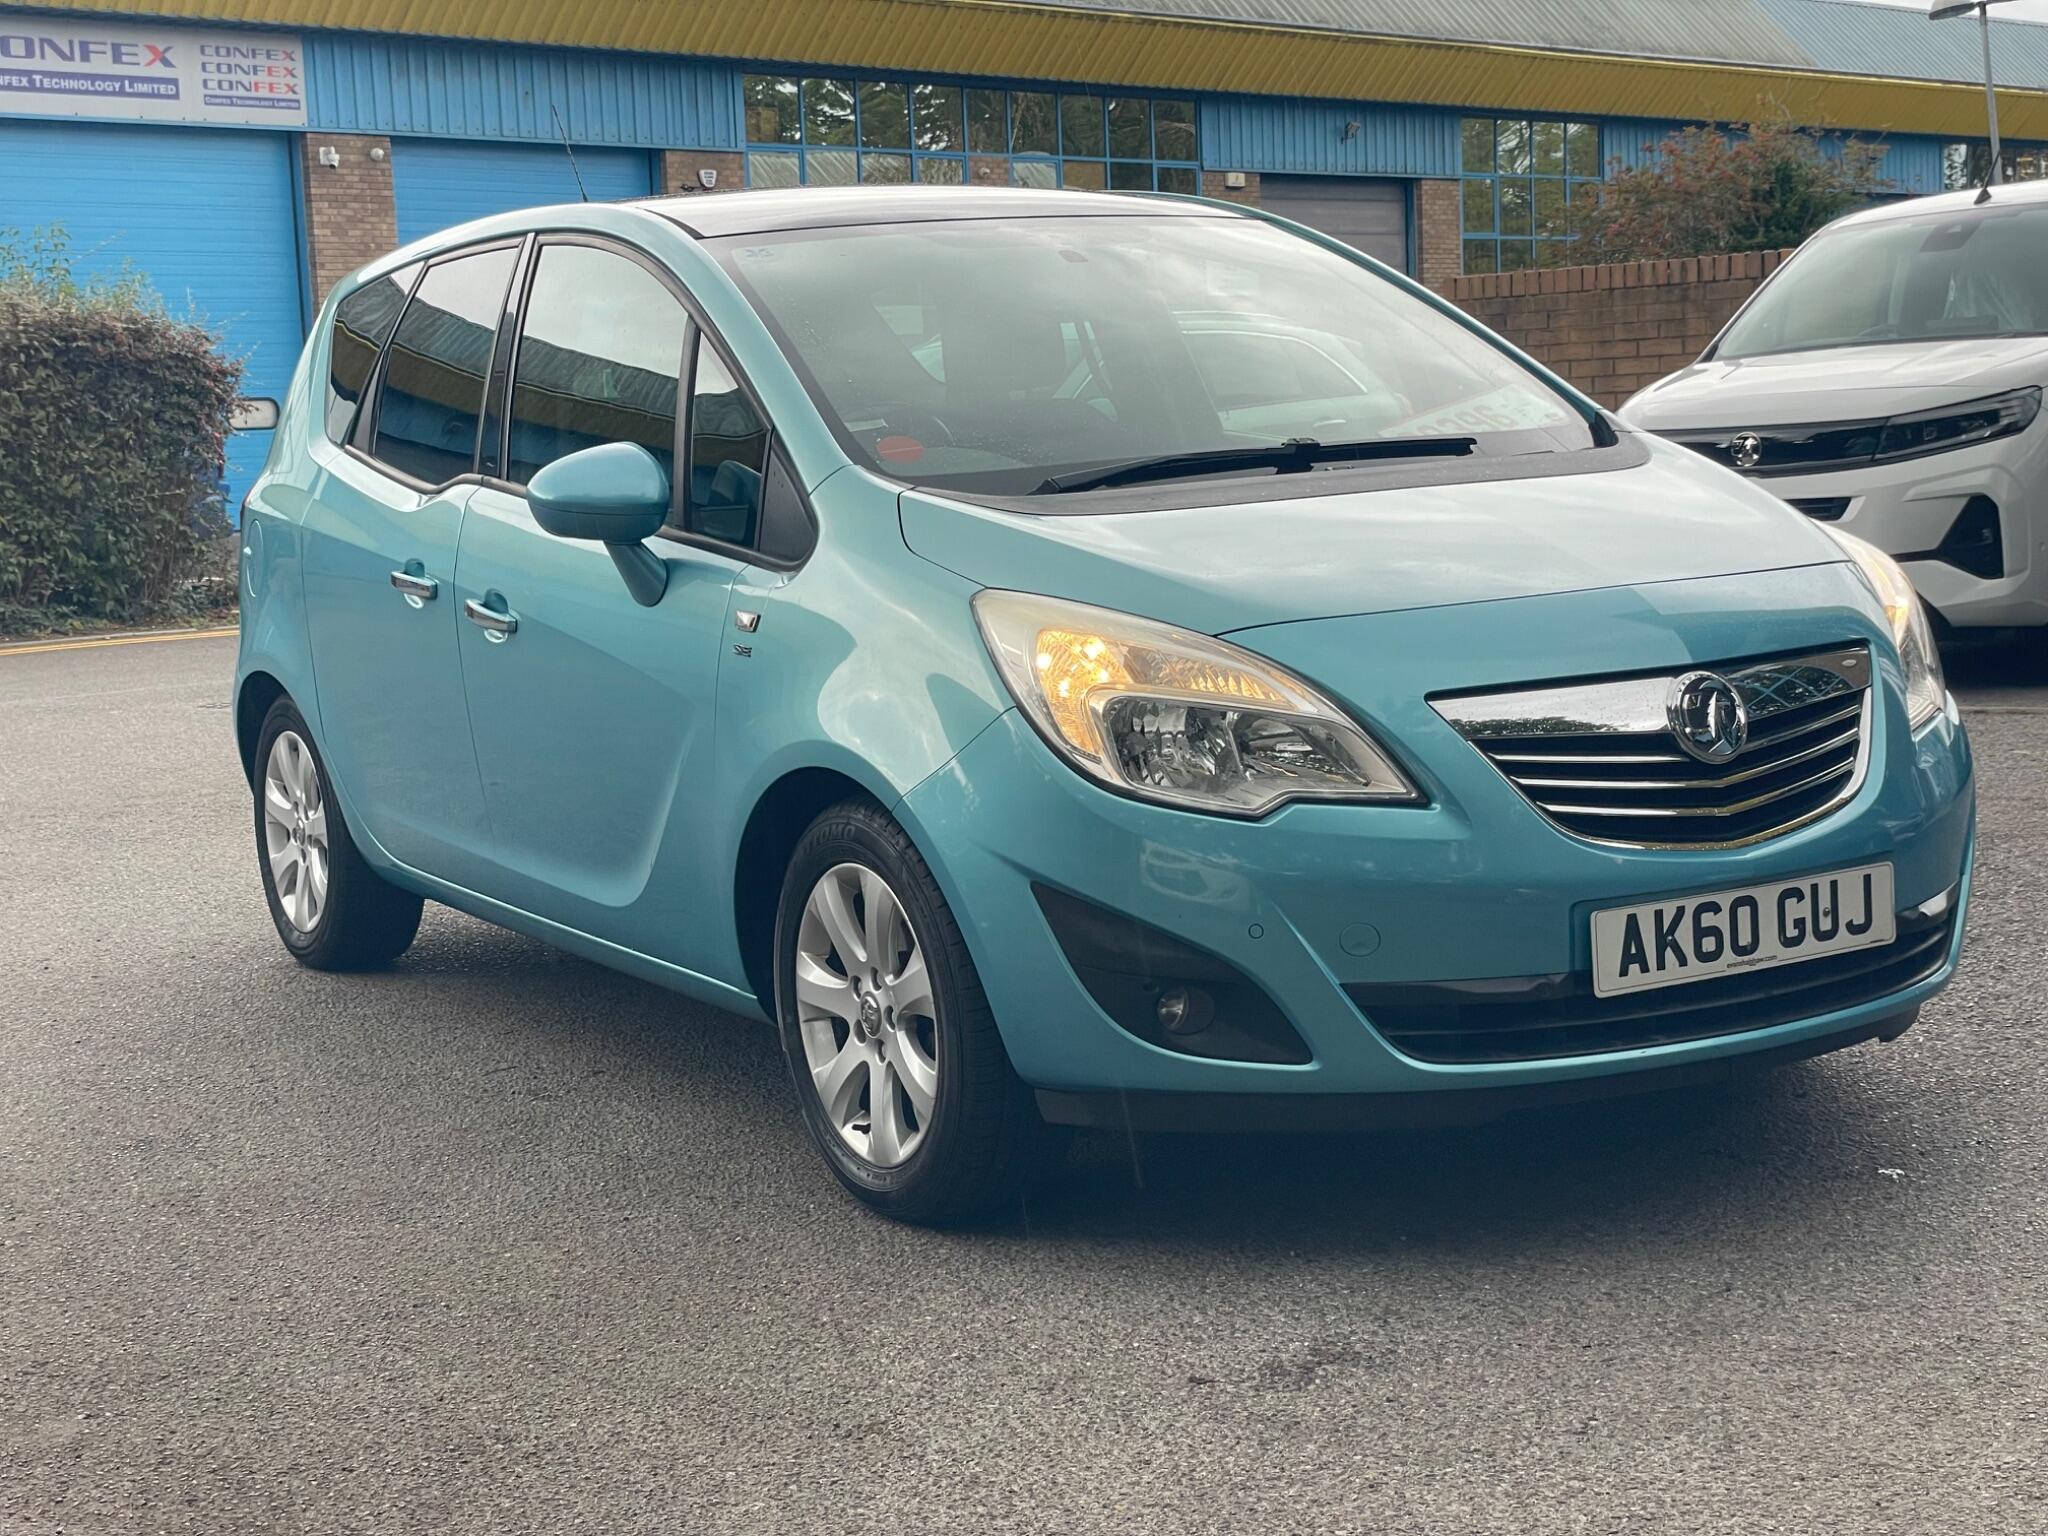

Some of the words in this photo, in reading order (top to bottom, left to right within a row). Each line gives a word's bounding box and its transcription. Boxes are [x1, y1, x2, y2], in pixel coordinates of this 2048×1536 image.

[200, 45, 296, 62] CONFEX
[201, 62, 298, 79] CONFEX
[32, 74, 121, 92] TECHNOLOGY
[124, 80, 177, 95] LIMITED
[203, 79, 299, 95] CONFEX
[1618, 894, 1761, 978] AK60
[1776, 873, 1873, 950] GUJ
